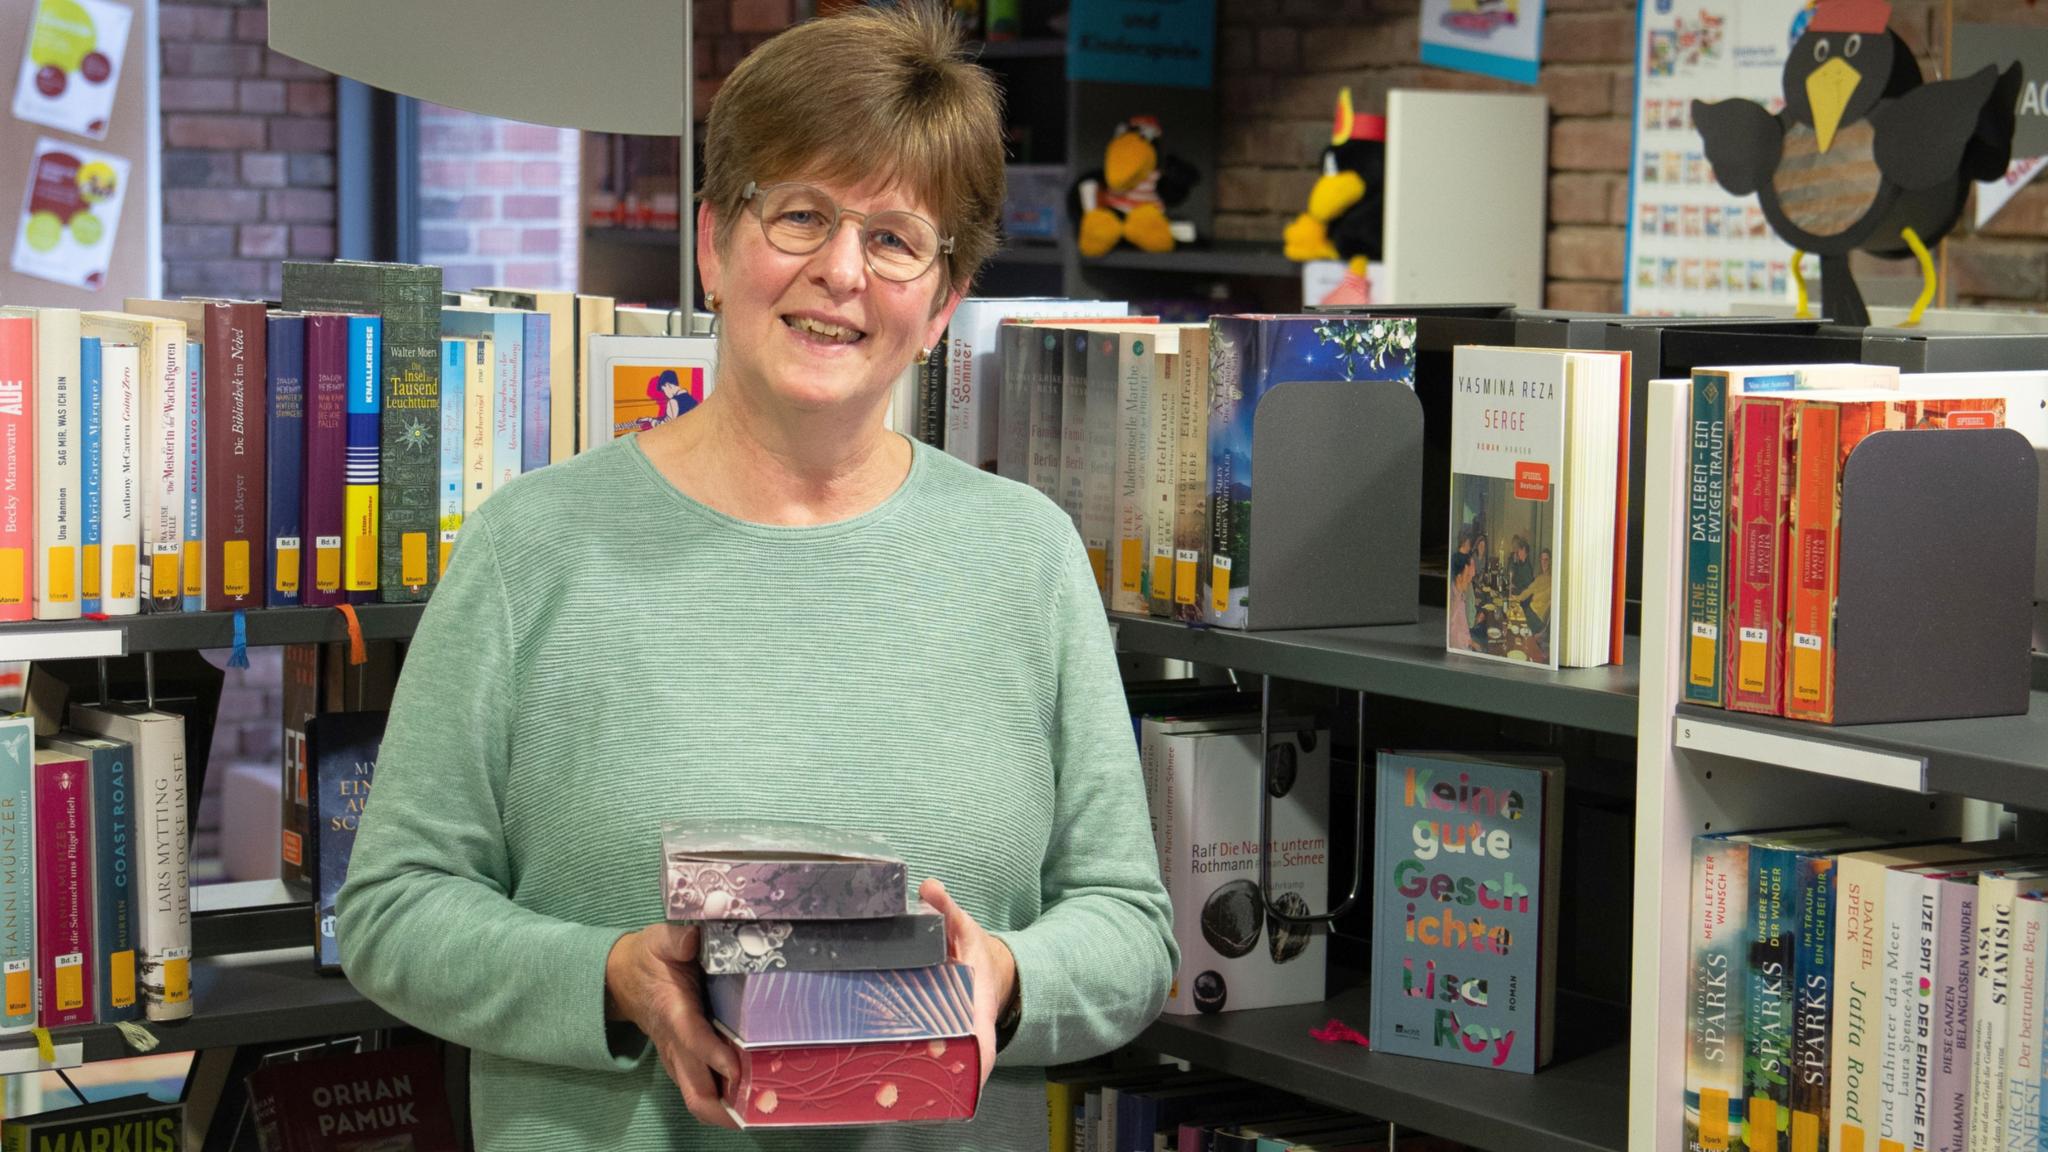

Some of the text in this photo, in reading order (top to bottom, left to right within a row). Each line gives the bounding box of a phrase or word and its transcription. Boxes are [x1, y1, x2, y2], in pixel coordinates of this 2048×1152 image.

[365, 326, 373, 403] KNALLKREBSE
[391, 347, 437, 358] Walter Moers
[404, 369, 426, 382] Insel
[960, 343, 972, 403] Sommer
[58, 377, 67, 391] BIN
[58, 394, 67, 407] ICH
[122, 367, 133, 422] Going Zero
[162, 343, 180, 481] Meisterin Wachsfiguren
[232, 329, 244, 455] Die Bibliothek im Nebel
[391, 377, 437, 396] Tausend
[1180, 350, 1192, 437] Eifelfrauen
[1214, 350, 1226, 416] ATLAS
[1459, 376, 1553, 400] YASMINA REZA
[58, 409, 67, 427] WAS
[474, 394, 484, 448] Bücherinsel
[1123, 366, 1139, 497] Mademoiselle Marthe
[1157, 393, 1168, 484] Eifelfrauen
[1485, 409, 1525, 431] SERGE
[5, 424, 19, 533] Becky Manawatu
[58, 450, 67, 466] SAG
[88, 378, 99, 541] Gabriel García Márquez
[122, 424, 133, 520] Anthony McCarten
[474, 455, 483, 472] Die
[1179, 451, 1187, 515] BRIGITTE
[1189, 452, 1197, 490] RIEBE
[1692, 420, 1708, 541] DAS LEBEN EIN
[1708, 420, 1724, 543] EWIGER TRAUM
[58, 488, 67, 540] Una Mannion
[235, 475, 245, 533] Kai Meyer
[1214, 497, 1222, 538] LUCINDA
[1219, 454, 1230, 551] HARRY WHITTAKER
[1757, 534, 1765, 573] MAGDA
[1811, 539, 1819, 579] MAGDA
[1697, 626, 1707, 634] Bd.
[1758, 631, 1763, 639] 2
[66, 797, 76, 828] verlieh
[1163, 747, 1175, 873] Die Nacht unterm Schnee
[1404, 768, 1524, 820] Keine
[19, 790, 30, 913] ist ein Sehnsuchtsort
[67, 831, 79, 858] Flügel
[112, 761, 127, 886] COAST ROAD
[155, 778, 171, 913] LARS MYTTING
[173, 752, 188, 925] DIE GLOCKE IM SEE
[1192, 842, 1218, 858] Ralf
[1220, 839, 1325, 856] Die unterm
[1412, 819, 1512, 861] gute
[1, 797, 18, 957] HANNI MÜNZER
[1192, 859, 1253, 874] Rothmann
[1283, 853, 1325, 867] Schnee
[1393, 858, 1529, 913] Gesch
[69, 880, 79, 928] Sehnsucht
[118, 900, 126, 947] MURRIN
[1704, 856, 1714, 939] MEIN LETZTER
[1716, 873, 1727, 925] WUNSCH
[1759, 868, 1768, 944] UNSERE ZEIT
[1770, 867, 1782, 948] DER WUNDER
[1804, 887, 1813, 948] IM TRAUM
[1815, 873, 1826, 965] BIN ICH BEI DIR
[1848, 883, 1860, 942] SPECK
[70, 930, 78, 945] die
[1405, 902, 1513, 956] ichte
[1862, 900, 1875, 970] DANIEL
[1920, 894, 1933, 973] LIZE SPIT
[1403, 956, 1488, 1008] Lisa
[1509, 975, 1517, 1011] ROMAN
[1957, 900, 1972, 1050] BELANGLOSEN WUNDER
[2018, 920, 2040, 1069] Der betrunkene Berg
[1705, 952, 1728, 1062] SPARKS
[1760, 961, 1783, 1073] SPARKS
[1804, 974, 1827, 1086] SPARKS
[1881, 921, 1900, 1138] Und dahinter das Meer
[1898, 971, 1914, 1096] Laura Spence-Ash
[1943, 985, 1955, 1075] DIESE GANZEN
[1434, 1008, 1516, 1066] Roy
[1846, 981, 1867, 1124] Jaffa Road
[1914, 1004, 1928, 1126] DER EHRLICHE
[312, 1075, 413, 1108] ORHAN
[318, 1102, 419, 1137] PAMUK
[40, 1118, 174, 1152] MARKUS
